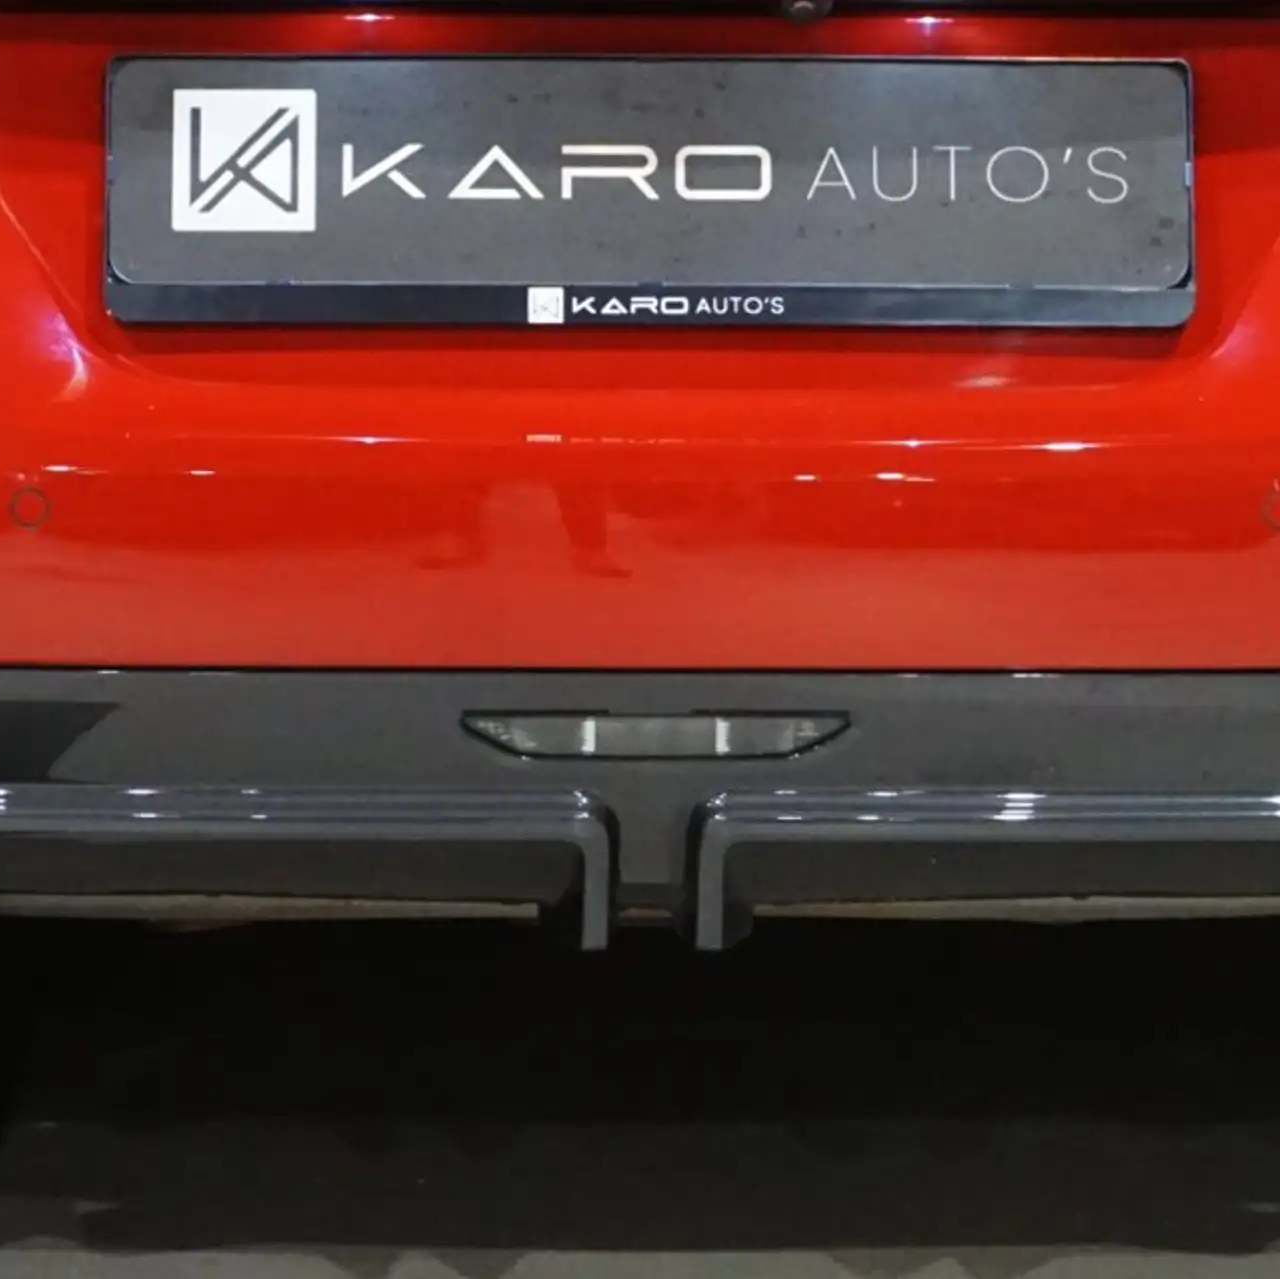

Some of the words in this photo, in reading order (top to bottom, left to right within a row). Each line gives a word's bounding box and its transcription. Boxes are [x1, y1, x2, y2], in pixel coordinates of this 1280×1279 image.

[340, 142, 773, 202] KARO
[806, 144, 1129, 205] AUTO'S
[571, 295, 690, 315] KARO
[695, 296, 785, 315] AUTO'S
